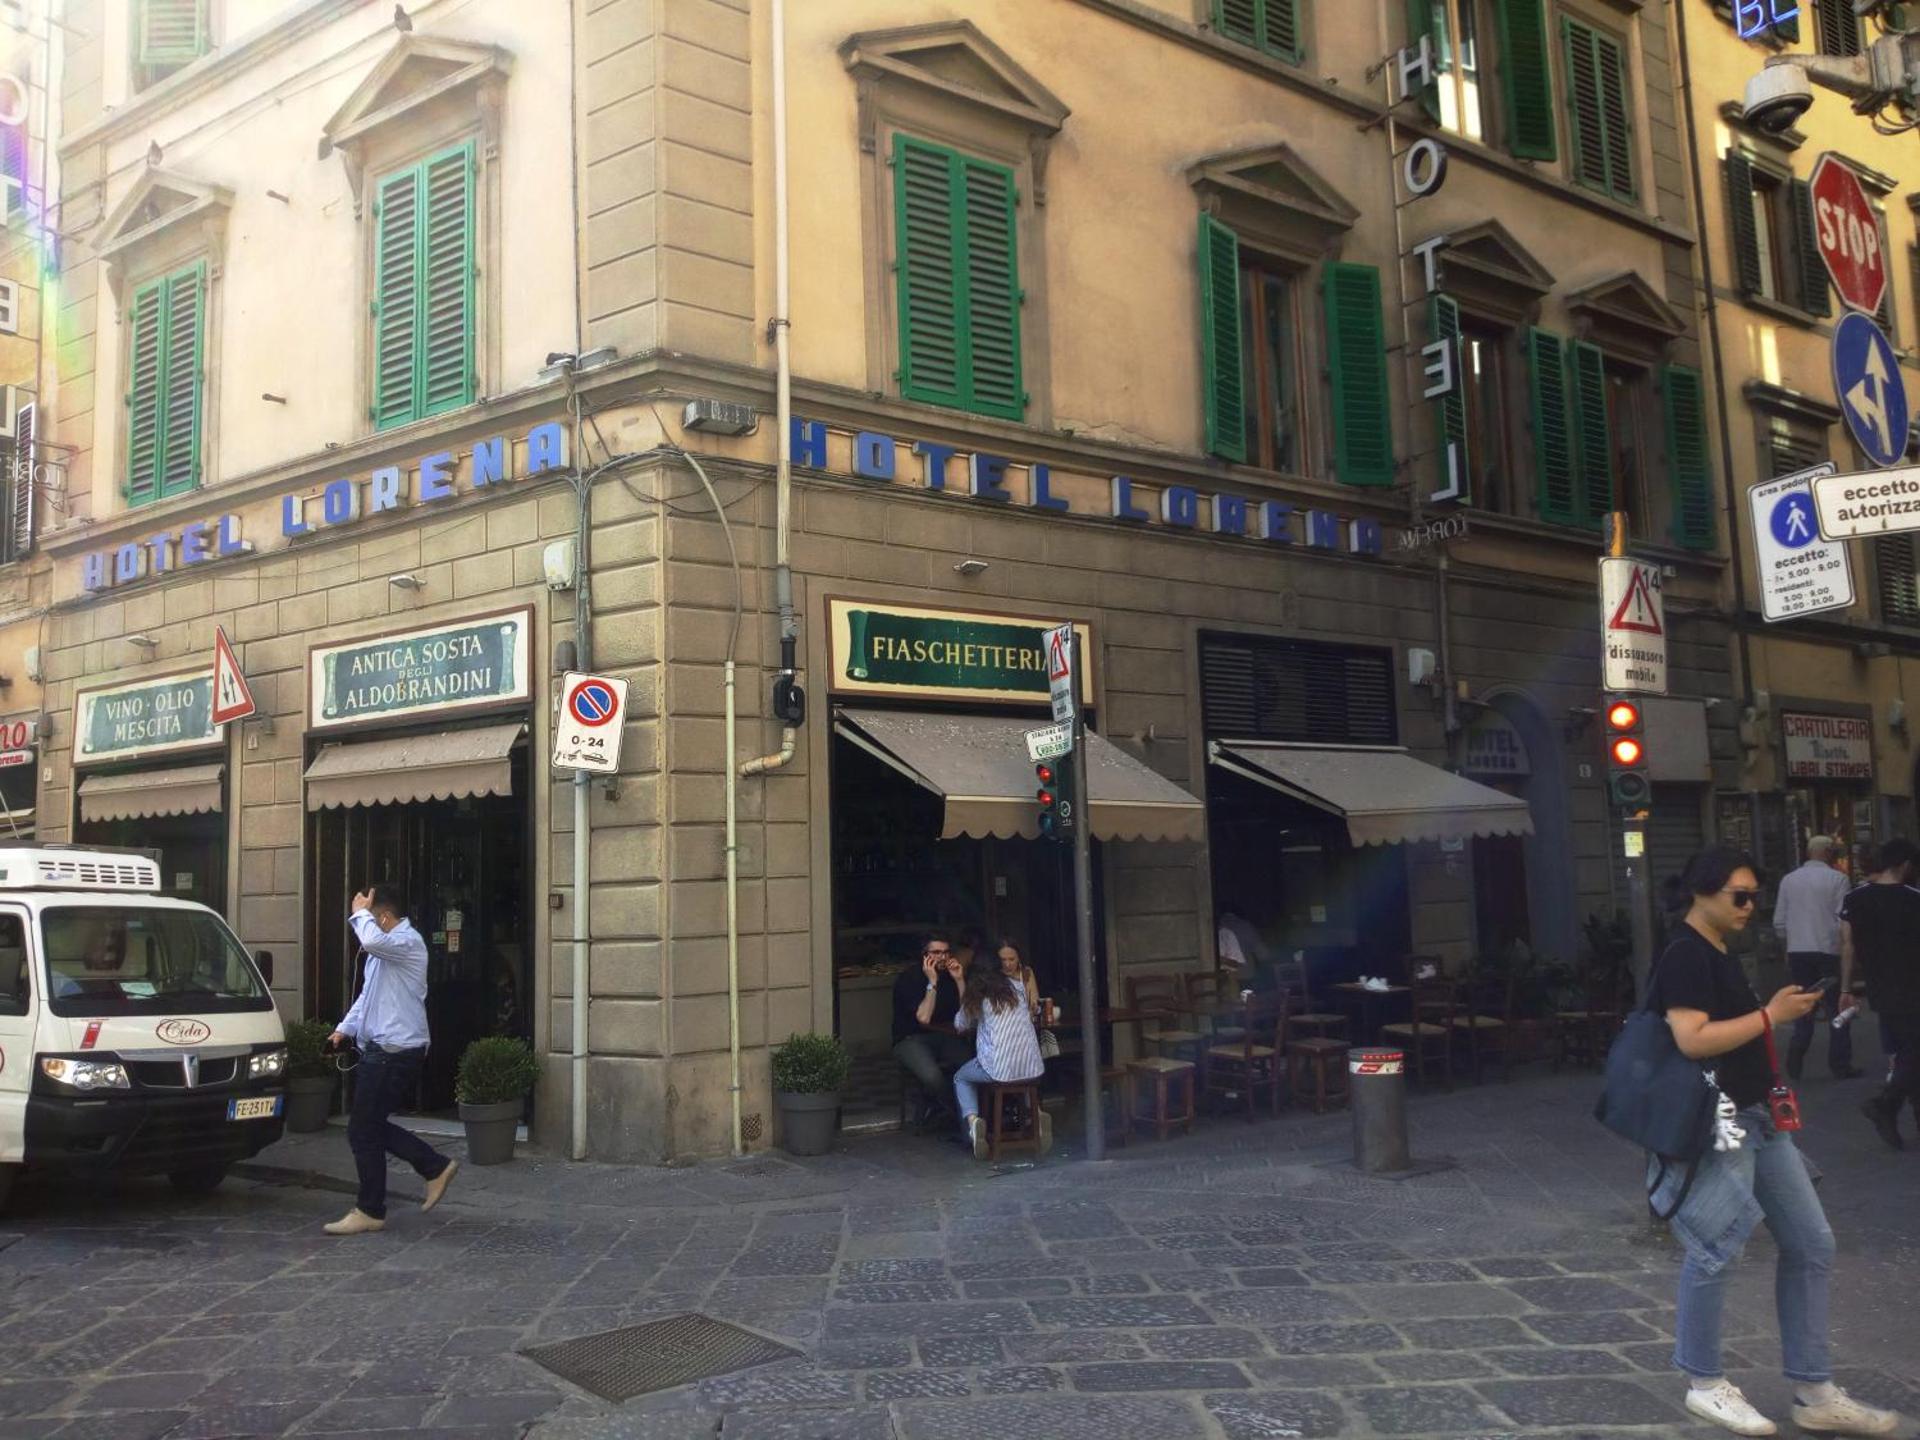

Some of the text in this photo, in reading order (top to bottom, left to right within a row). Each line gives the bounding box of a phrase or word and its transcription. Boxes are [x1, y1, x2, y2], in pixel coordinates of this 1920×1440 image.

[1818, 197, 1877, 271] STOP
[790, 416, 1384, 554] HOTEL LORENA
[1844, 480, 1920, 501] eccetto
[84, 422, 568, 591] HOTEL LORENA
[1642, 568, 1661, 593] 14
[351, 634, 484, 677] ANTICA SOSTA
[873, 636, 1048, 672] FIASCHETTERI
[344, 667, 492, 711] ALDOBRANDINI
[399, 665, 433, 680] DEGLI
[106, 687, 194, 721] VINO OLIO
[114, 714, 182, 742] MESCITA
